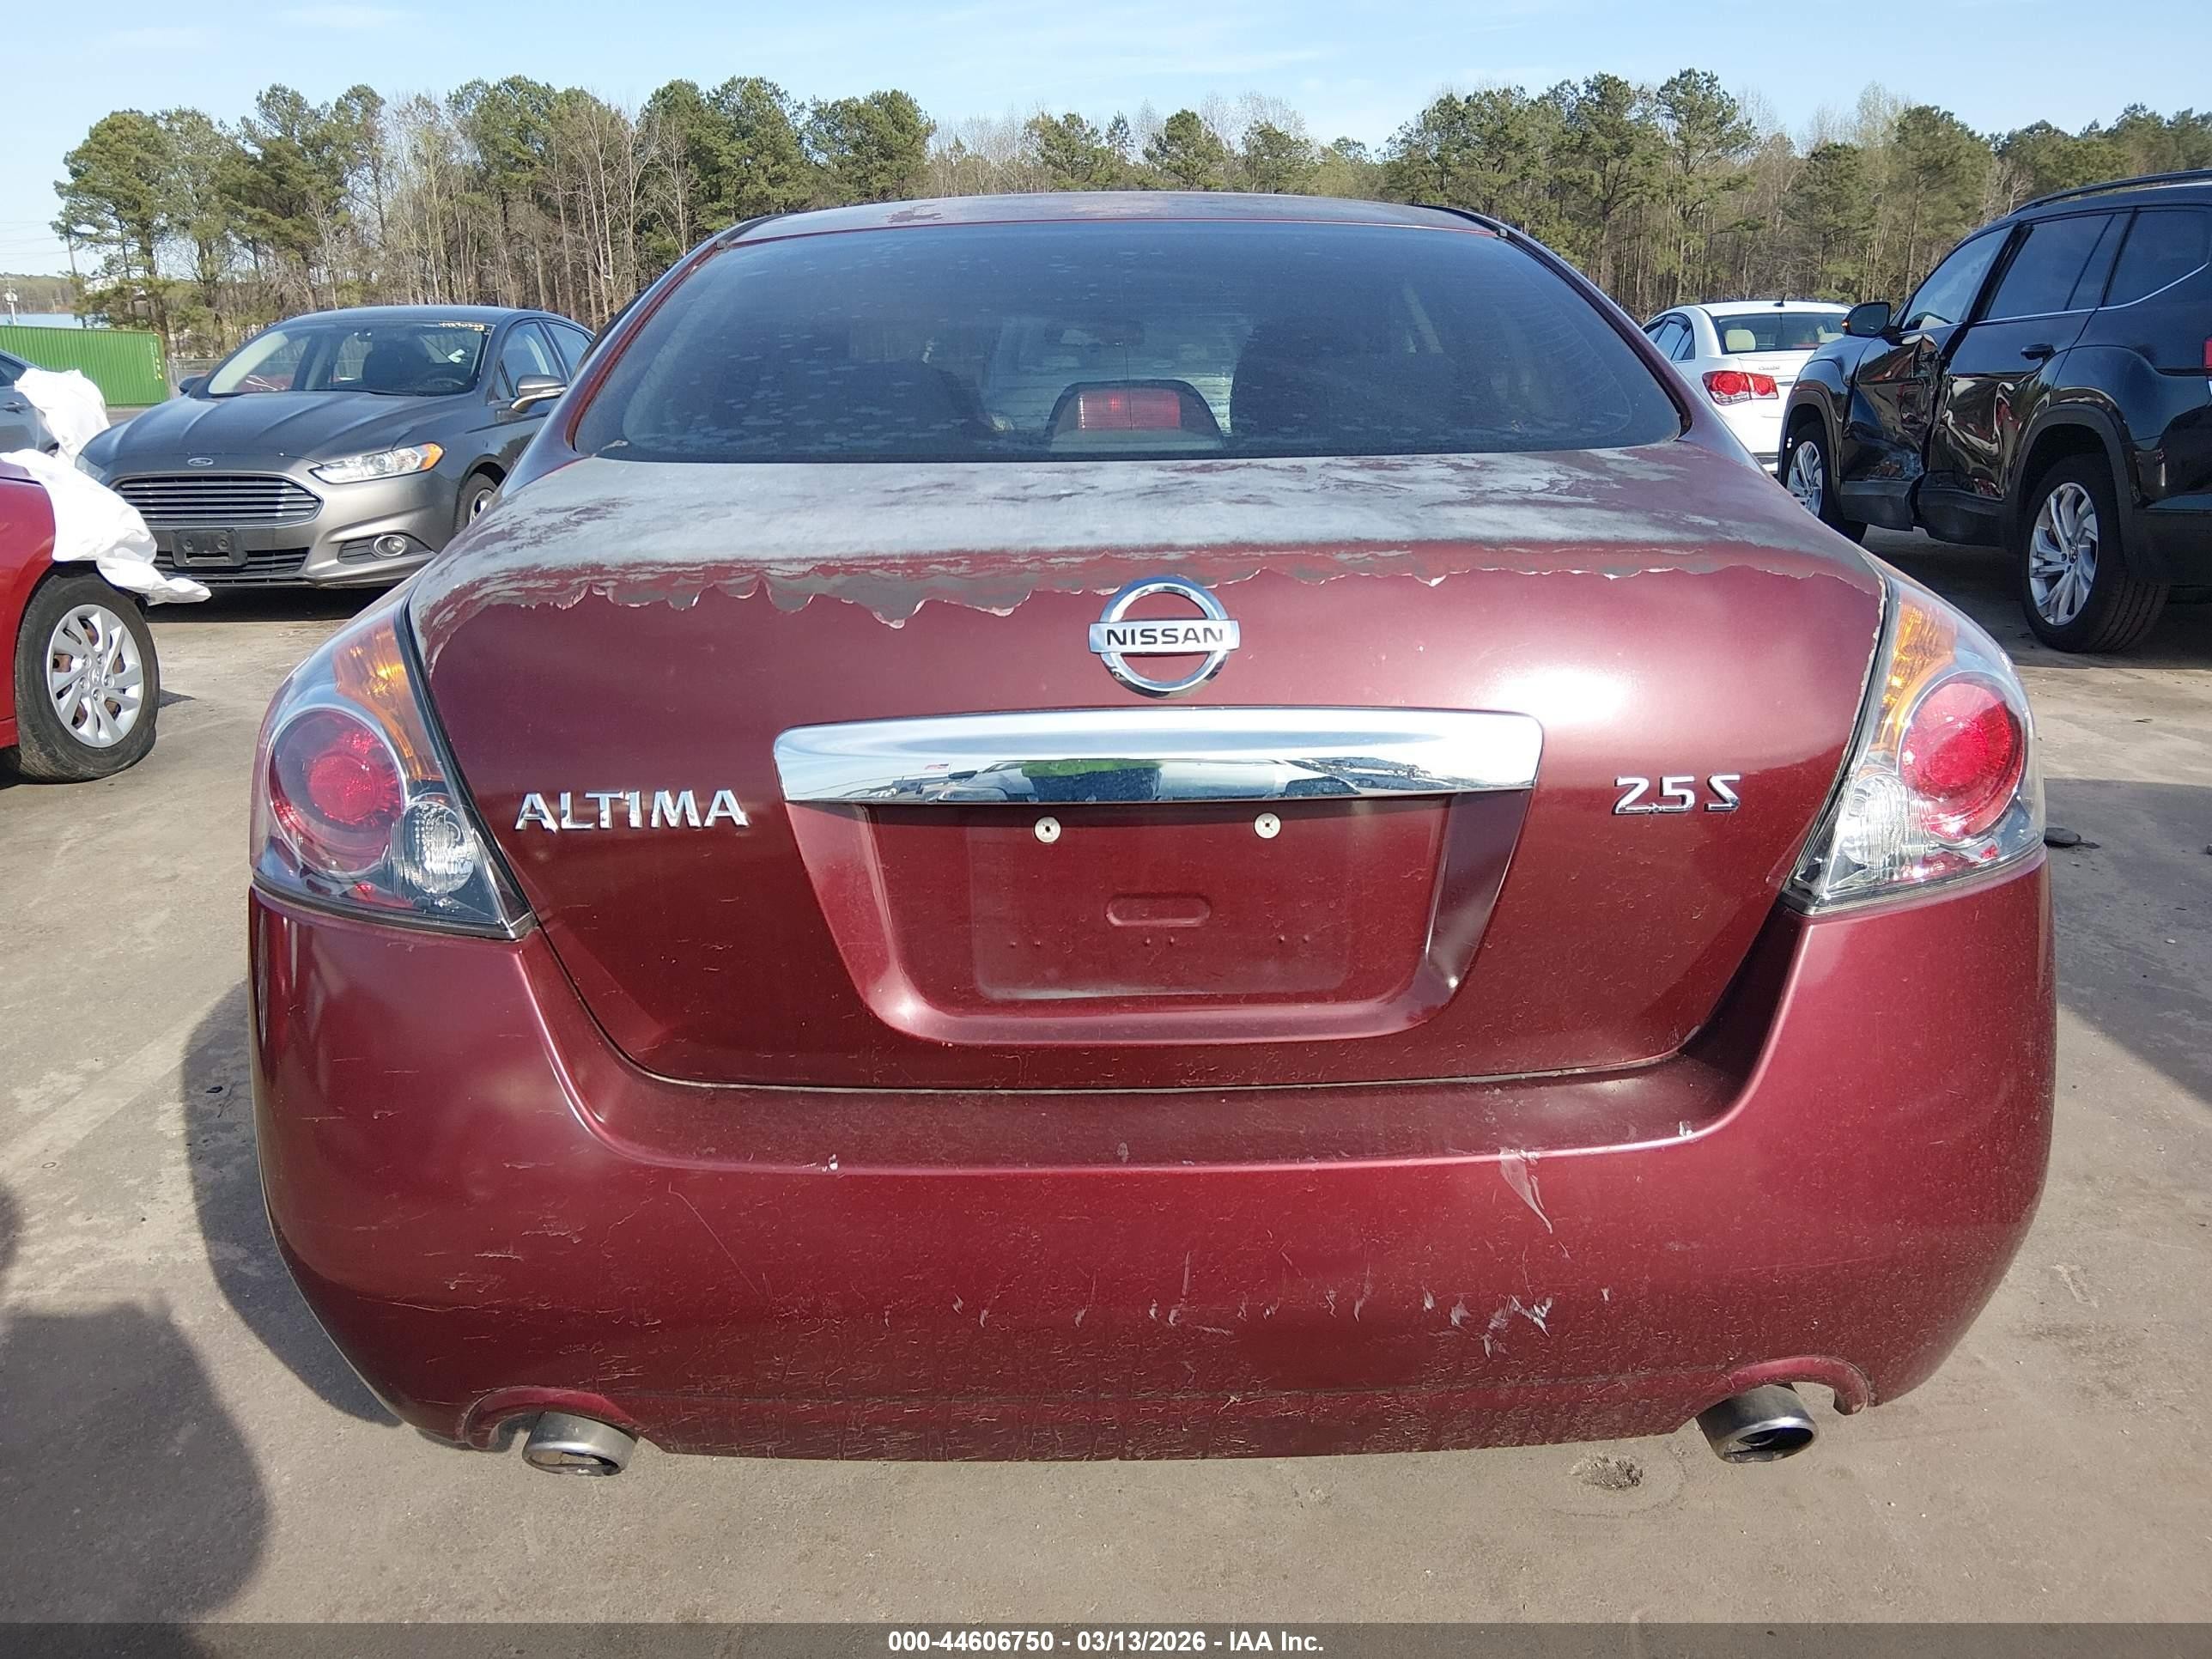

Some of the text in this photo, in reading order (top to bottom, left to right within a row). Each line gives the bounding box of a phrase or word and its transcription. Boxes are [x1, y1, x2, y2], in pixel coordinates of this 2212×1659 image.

[1106, 627, 1223, 646] NISSAN
[514, 789, 750, 833] ALTIMA
[1705, 775, 1741, 811] S
